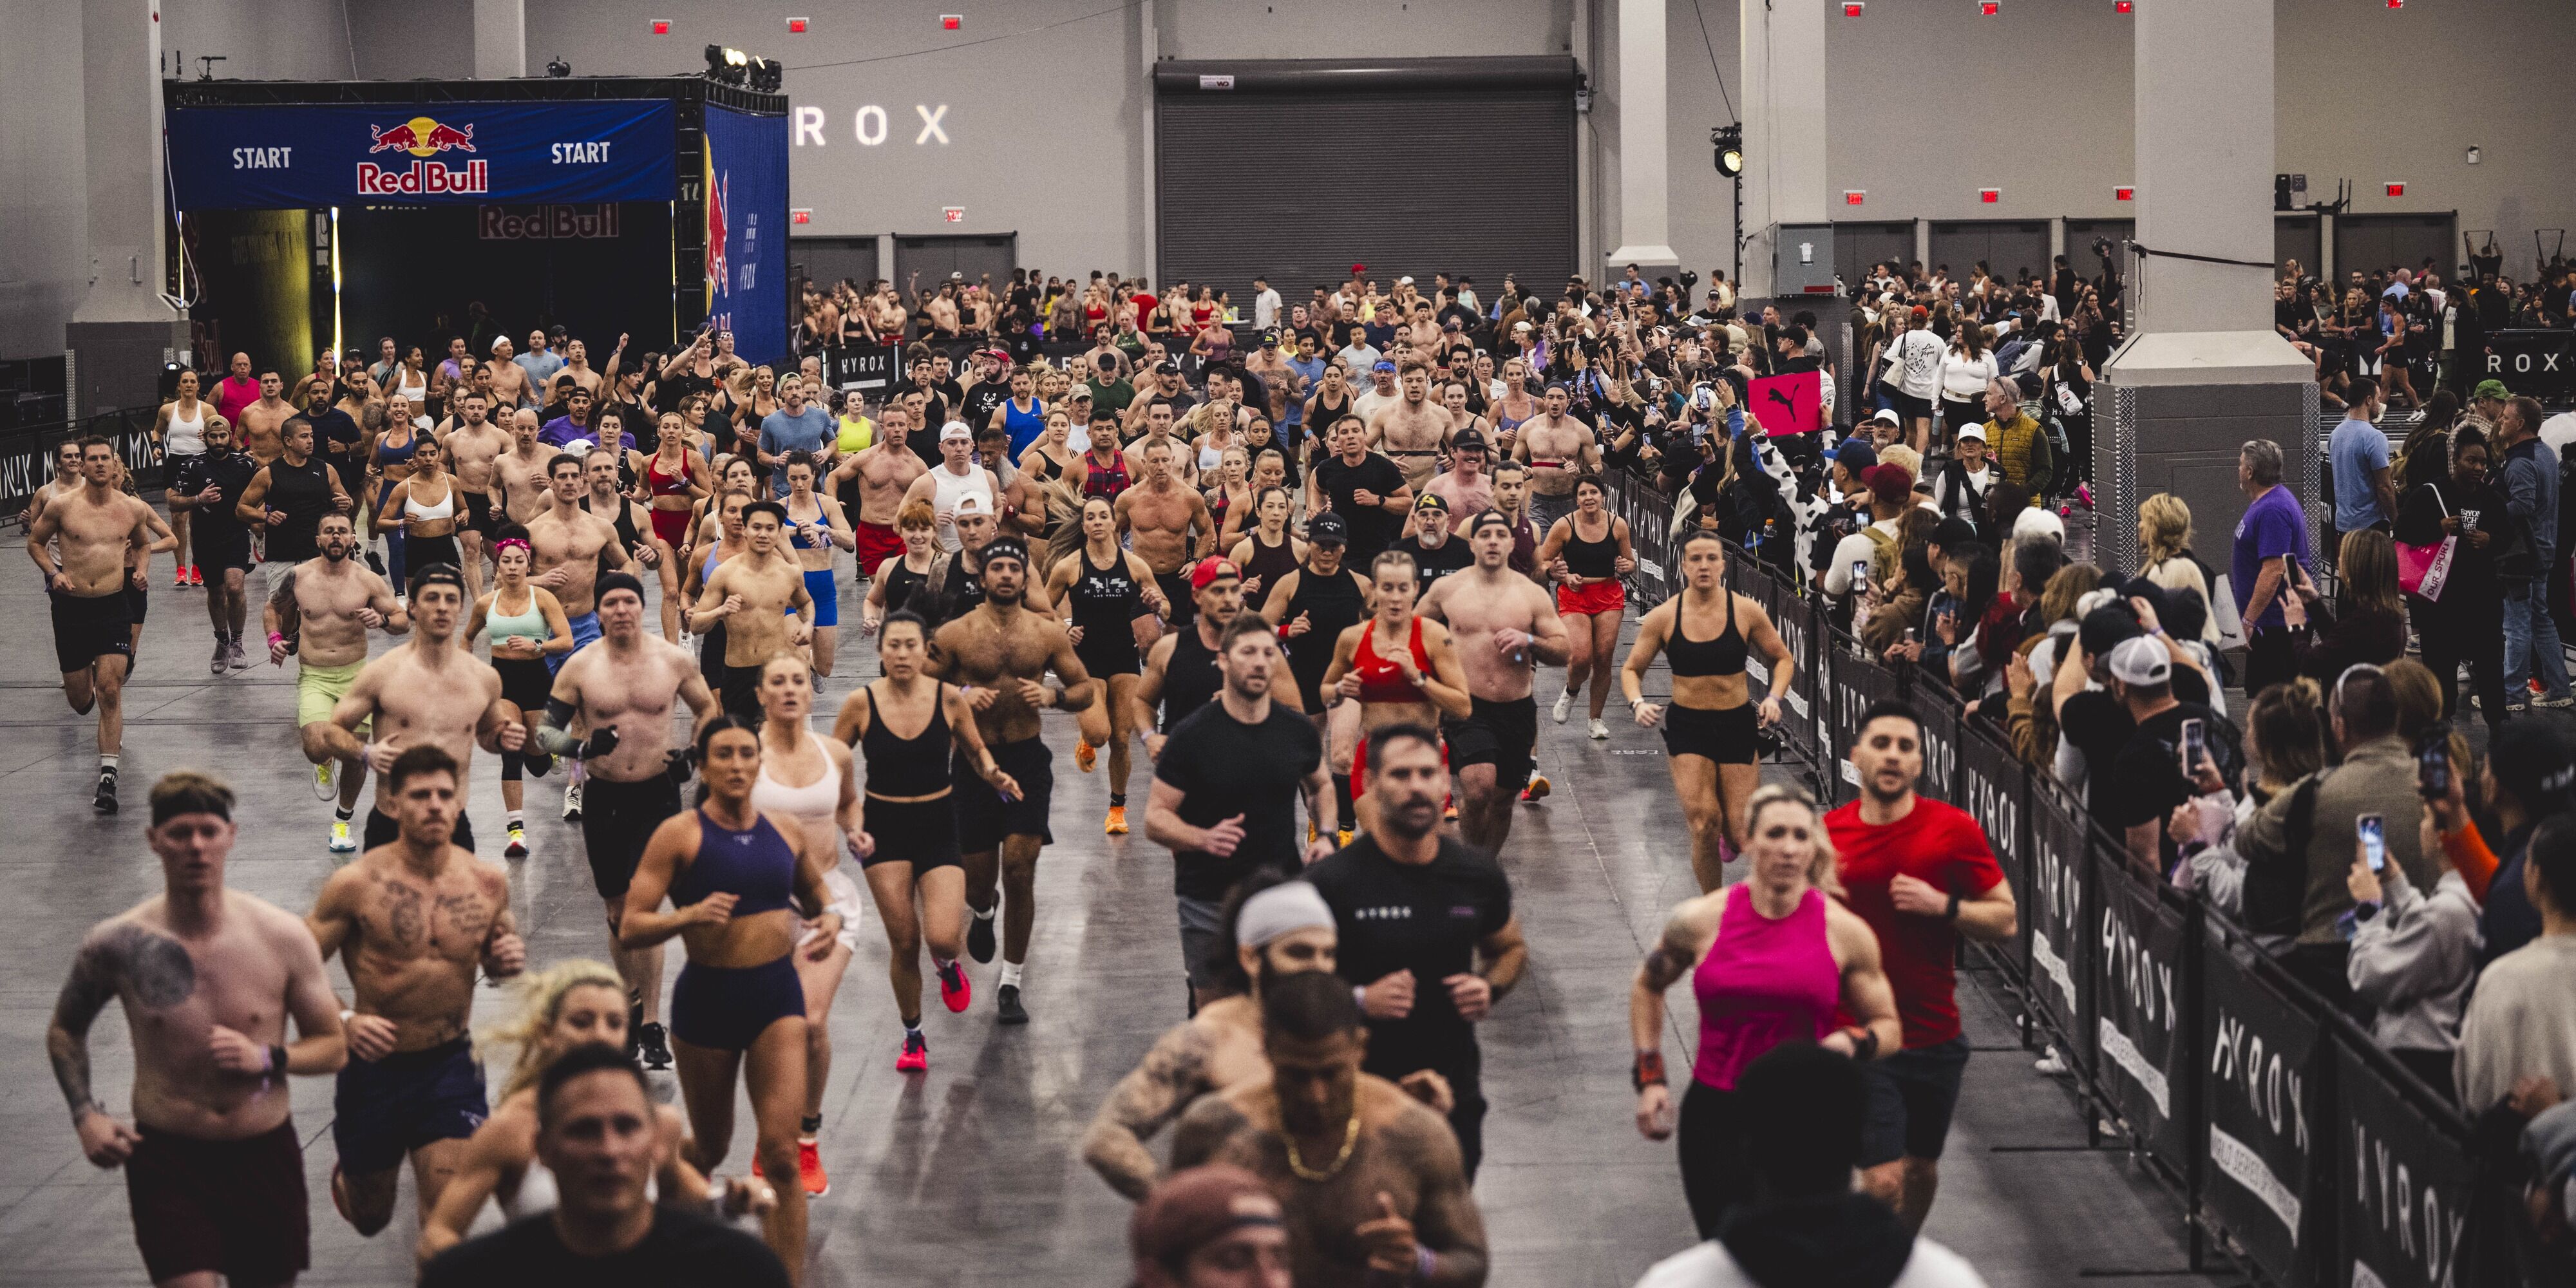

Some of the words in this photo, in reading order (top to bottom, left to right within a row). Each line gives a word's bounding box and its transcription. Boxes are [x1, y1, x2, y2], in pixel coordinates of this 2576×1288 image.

[232, 147, 292, 169] START
[551, 142, 611, 164] START
[357, 160, 422, 194] Red
[425, 159, 488, 193] Bull
[479, 204, 548, 239] Red
[552, 202, 619, 238] Bull
[842, 355, 885, 374] HYROX
[2211, 1006, 2310, 1157] HYROX
